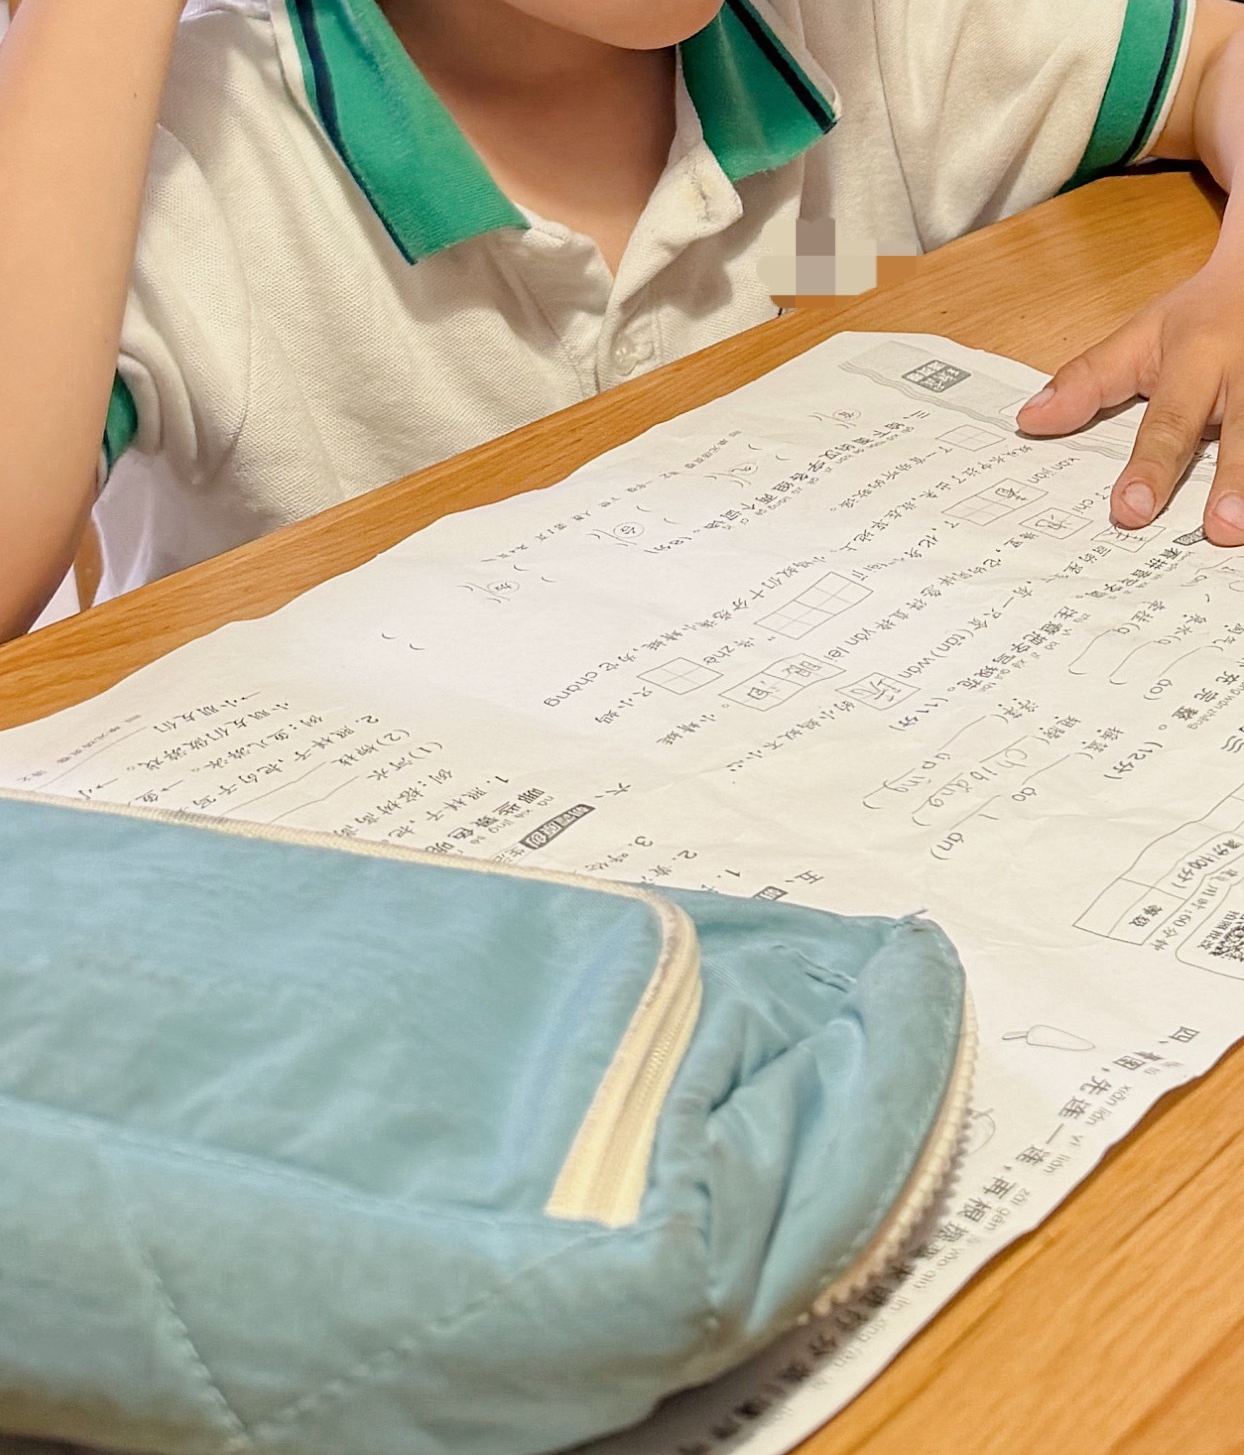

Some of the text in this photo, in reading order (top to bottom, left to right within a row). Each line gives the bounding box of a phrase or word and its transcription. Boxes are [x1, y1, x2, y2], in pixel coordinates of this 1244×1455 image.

[543, 670, 600, 708] chàng
[176, 724, 355, 814] 照样子,把句子写
[1127, 902, 1164, 929] 等级
